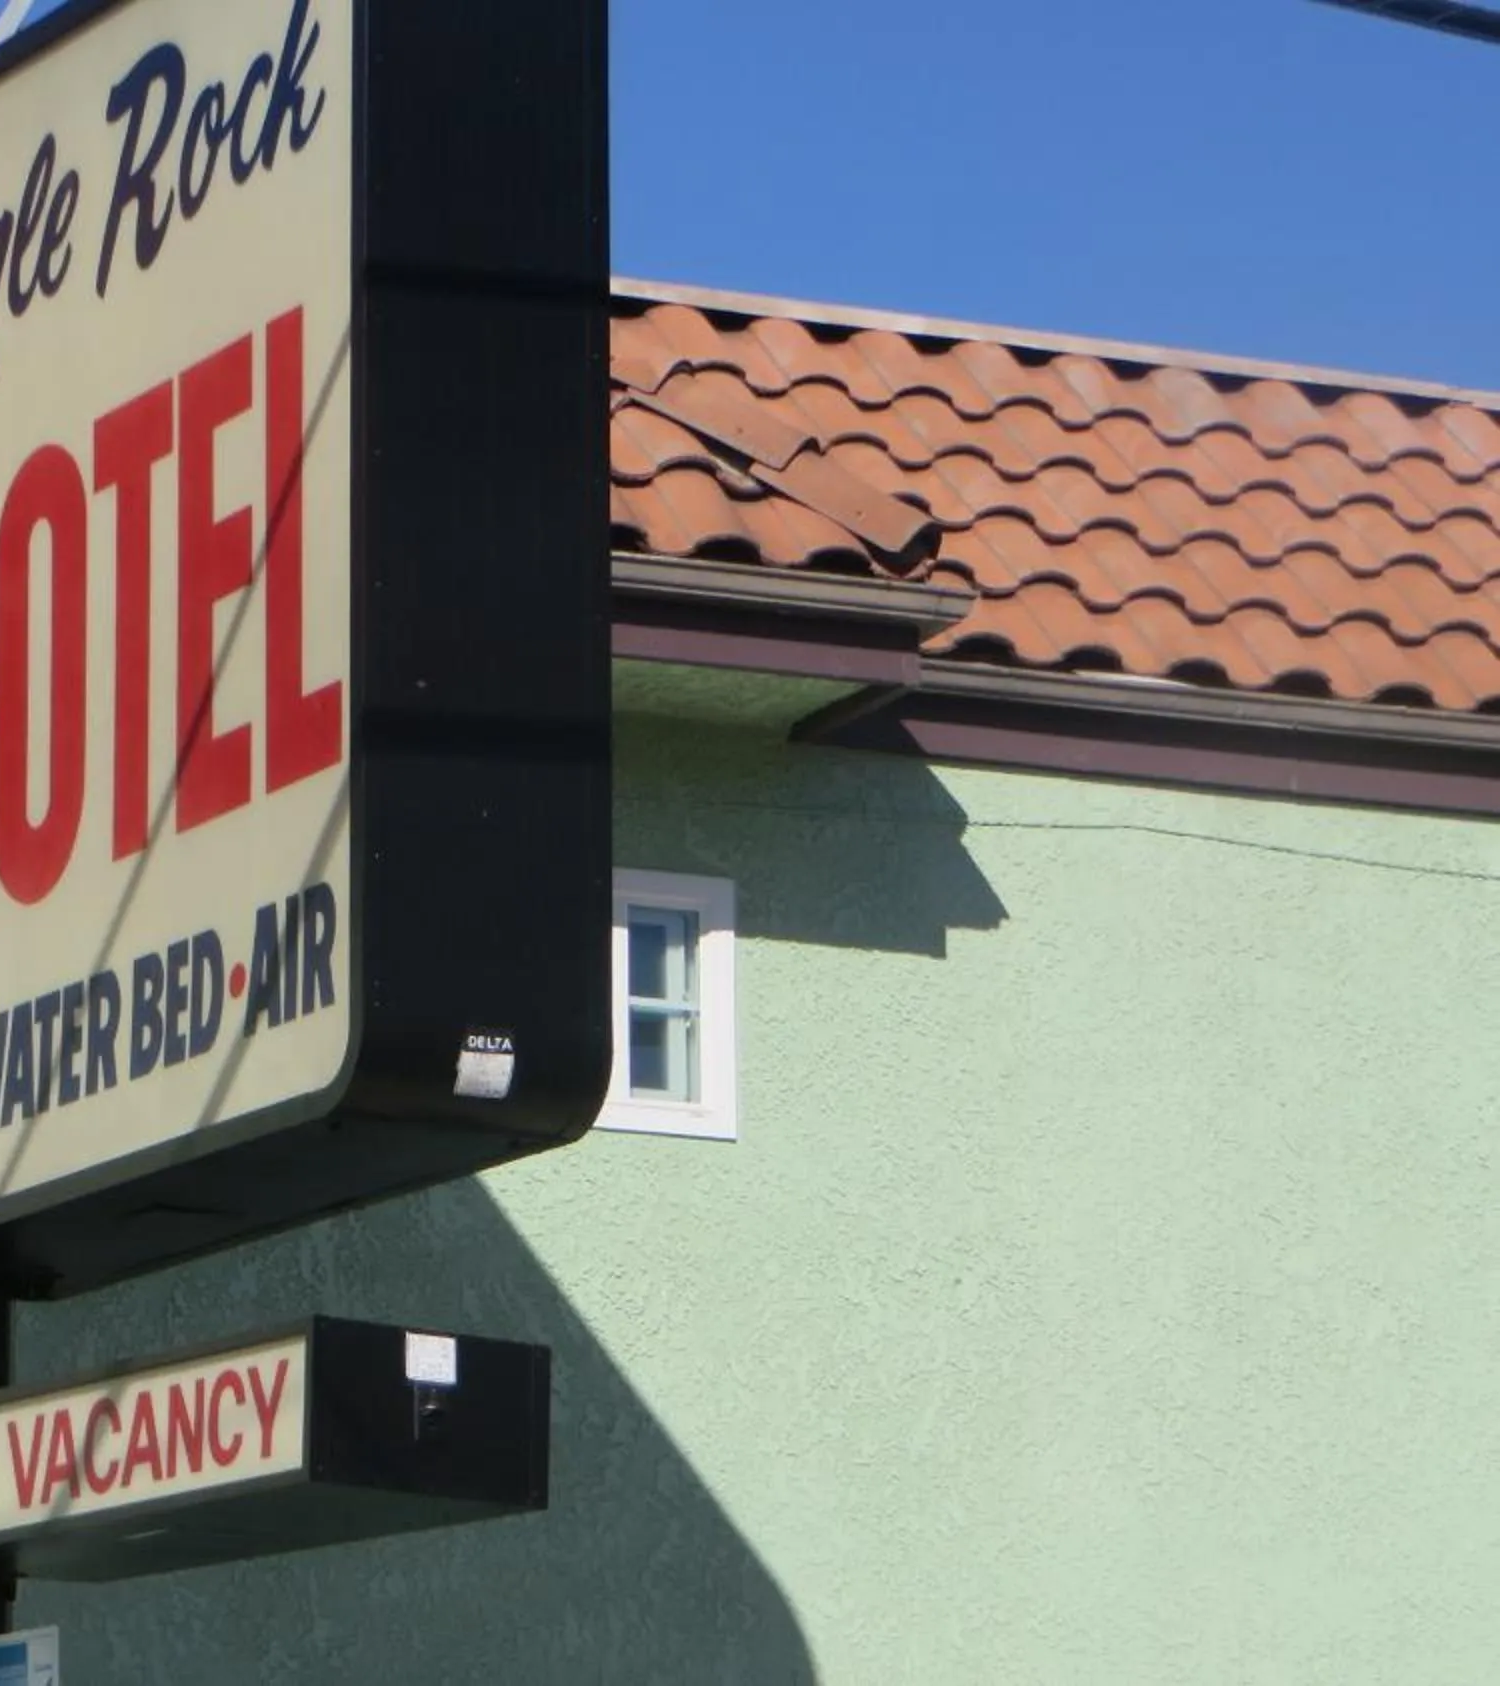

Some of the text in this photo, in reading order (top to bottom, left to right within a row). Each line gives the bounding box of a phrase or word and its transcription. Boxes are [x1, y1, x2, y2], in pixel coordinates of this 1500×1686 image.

[95, 0, 326, 299] Rock
[129, 928, 225, 1081] BED
[244, 881, 337, 1039] AIR
[467, 1035, 514, 1052] DELTA
[7, 1358, 290, 1511] VACANCY
